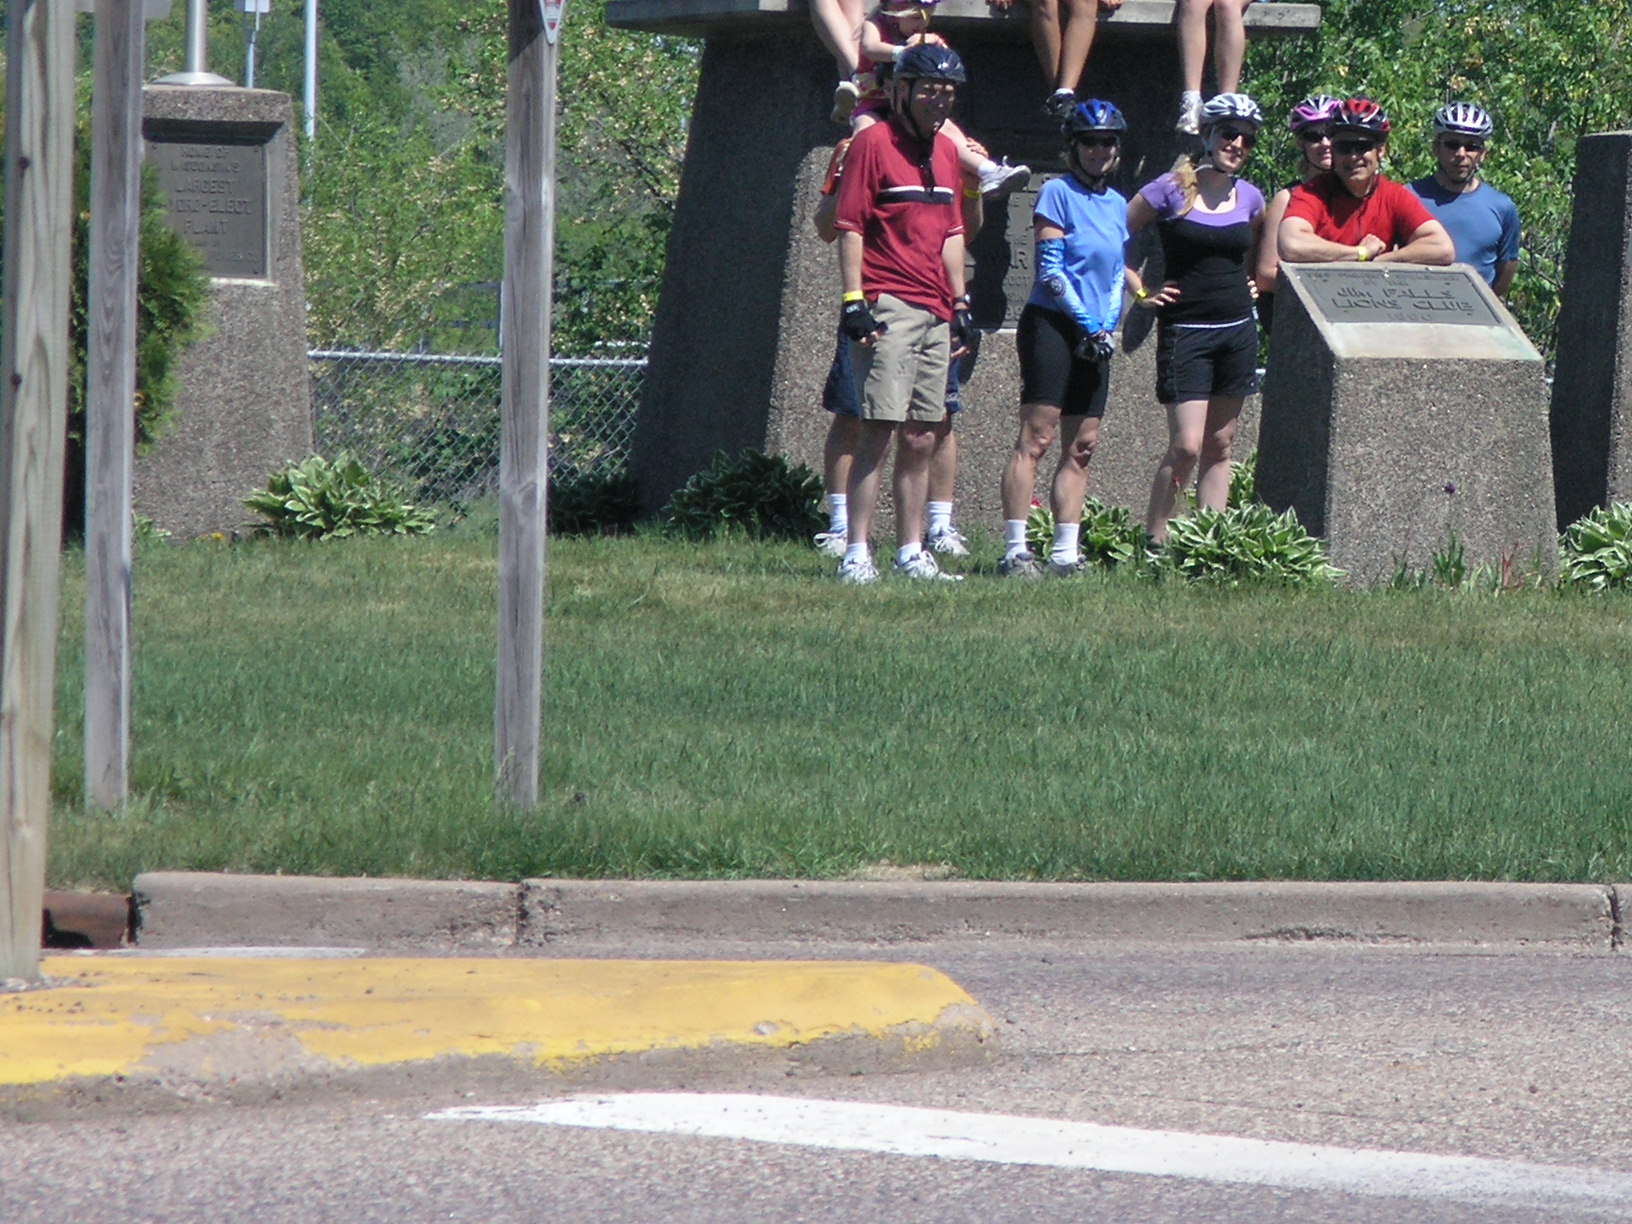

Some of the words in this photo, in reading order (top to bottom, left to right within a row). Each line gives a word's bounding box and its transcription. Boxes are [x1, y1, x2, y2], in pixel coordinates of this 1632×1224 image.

[175, 177, 235, 194] LARGEST
[183, 218, 228, 235] PLANT
[1382, 287, 1456, 300] FALLS
[1331, 298, 1402, 310] LIONS
